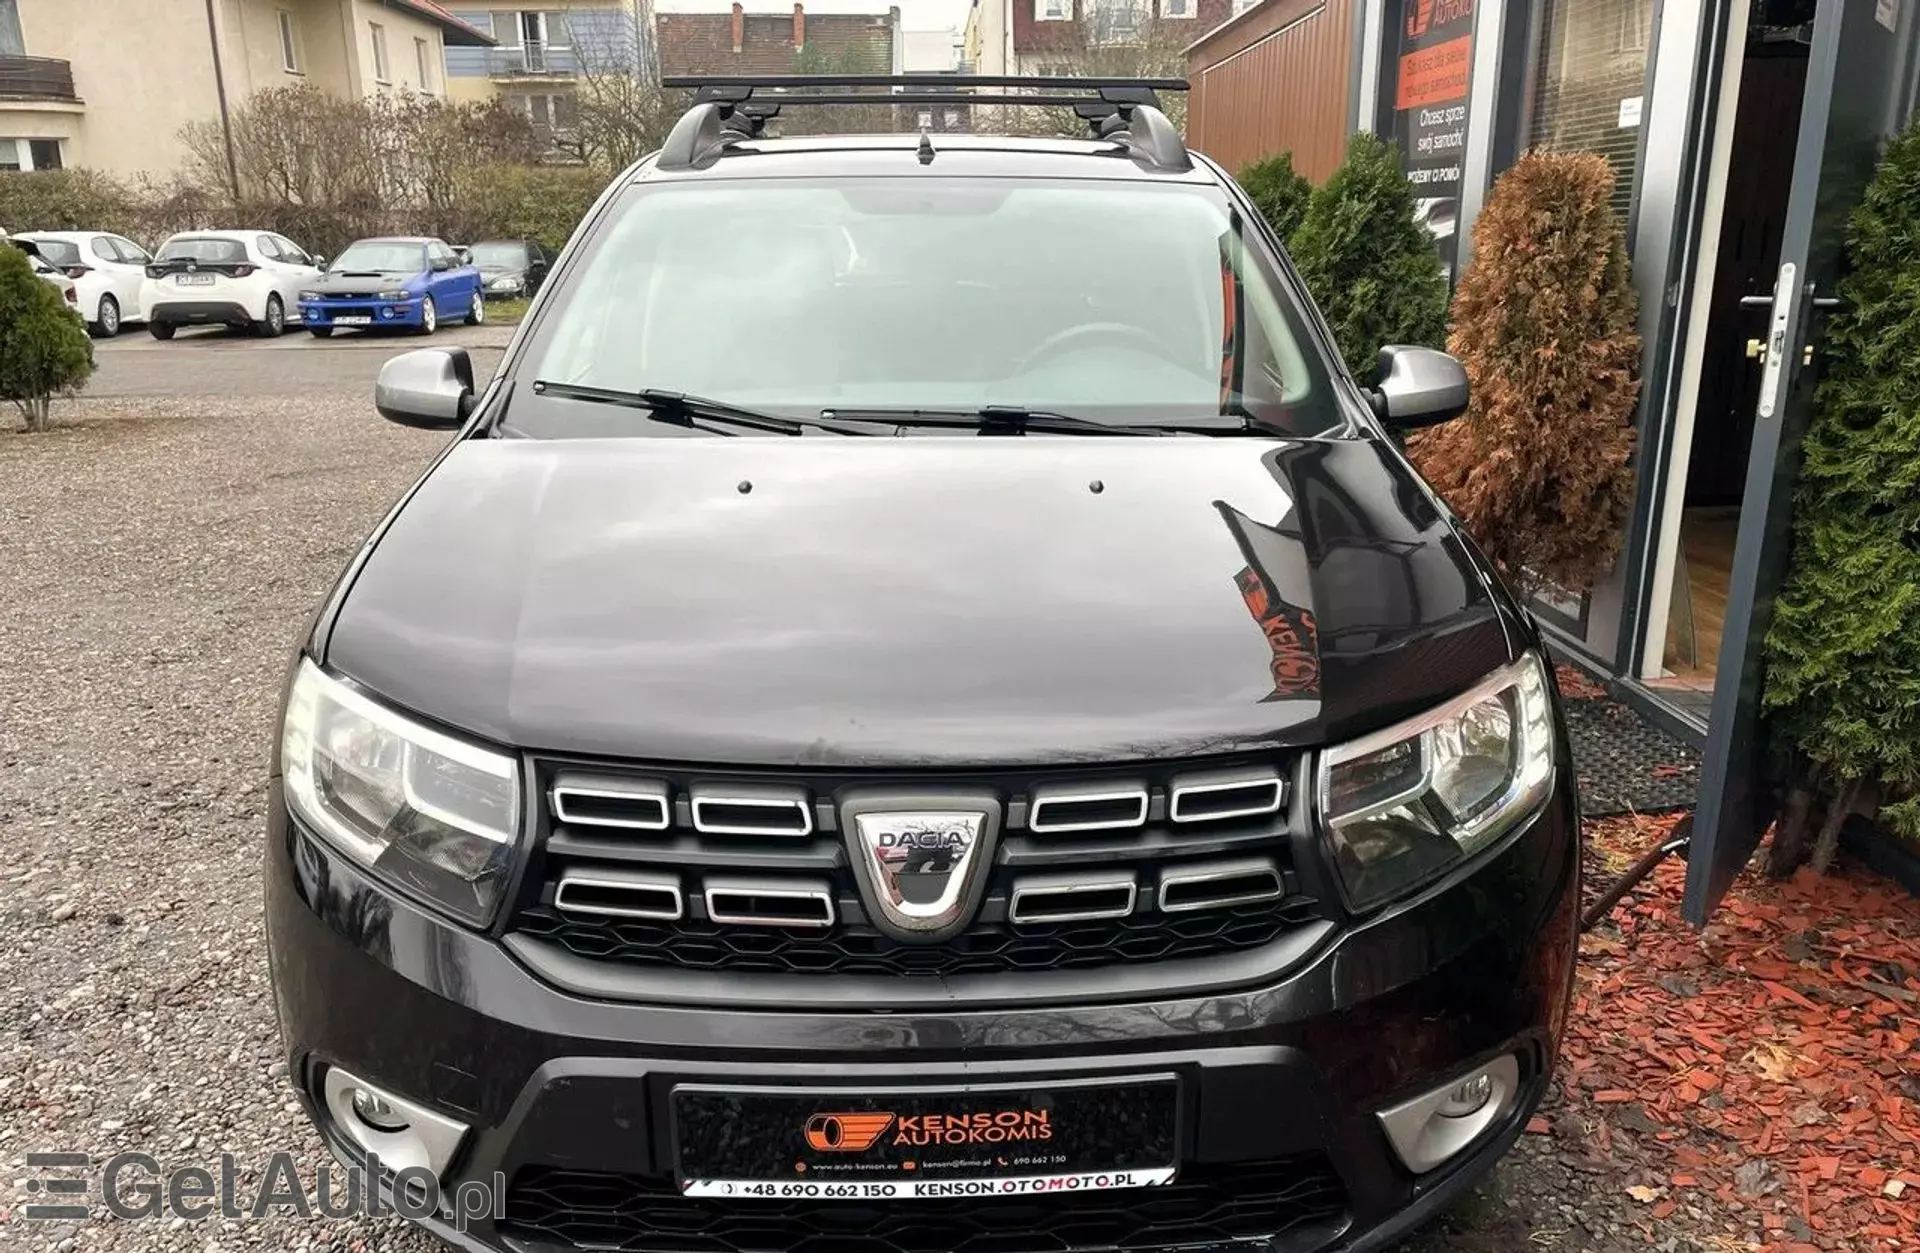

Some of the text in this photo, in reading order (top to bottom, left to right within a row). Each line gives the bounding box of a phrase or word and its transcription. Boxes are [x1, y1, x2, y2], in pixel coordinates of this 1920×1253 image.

[1420, 109, 1445, 127] Chcesz
[1417, 132, 1434, 154] swój
[879, 832, 965, 849] DACIA
[898, 1110, 1048, 1131] KENSON
[892, 1123, 1053, 1146] AUTOKOMIS
[812, 1161, 898, 1171] www.auto-kenson.eu
[1014, 1155, 1067, 1165] 690 662 150
[743, 1183, 897, 1197] +48 690 662 150
[914, 1173, 1137, 1197] KENSON.OTOMOTO.PL
